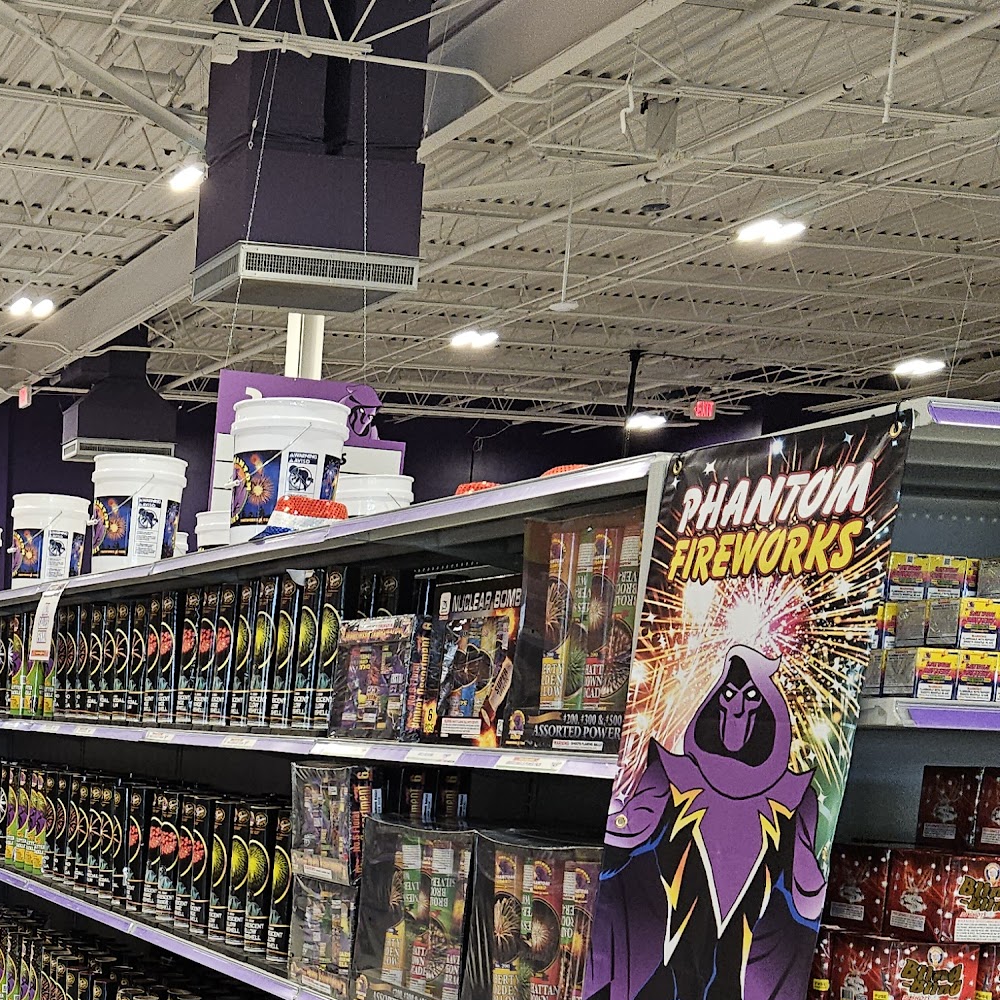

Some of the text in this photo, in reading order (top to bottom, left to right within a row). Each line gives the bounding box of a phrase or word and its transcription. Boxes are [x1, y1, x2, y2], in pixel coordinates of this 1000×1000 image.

[677, 460, 875, 534] PHANTOM
[667, 518, 864, 585] FIREWORKS
[452, 588, 522, 612] NUCLEAR BOMB
[428, 708, 433, 722] 6
[533, 725, 621, 740] ASSORTED POWER
